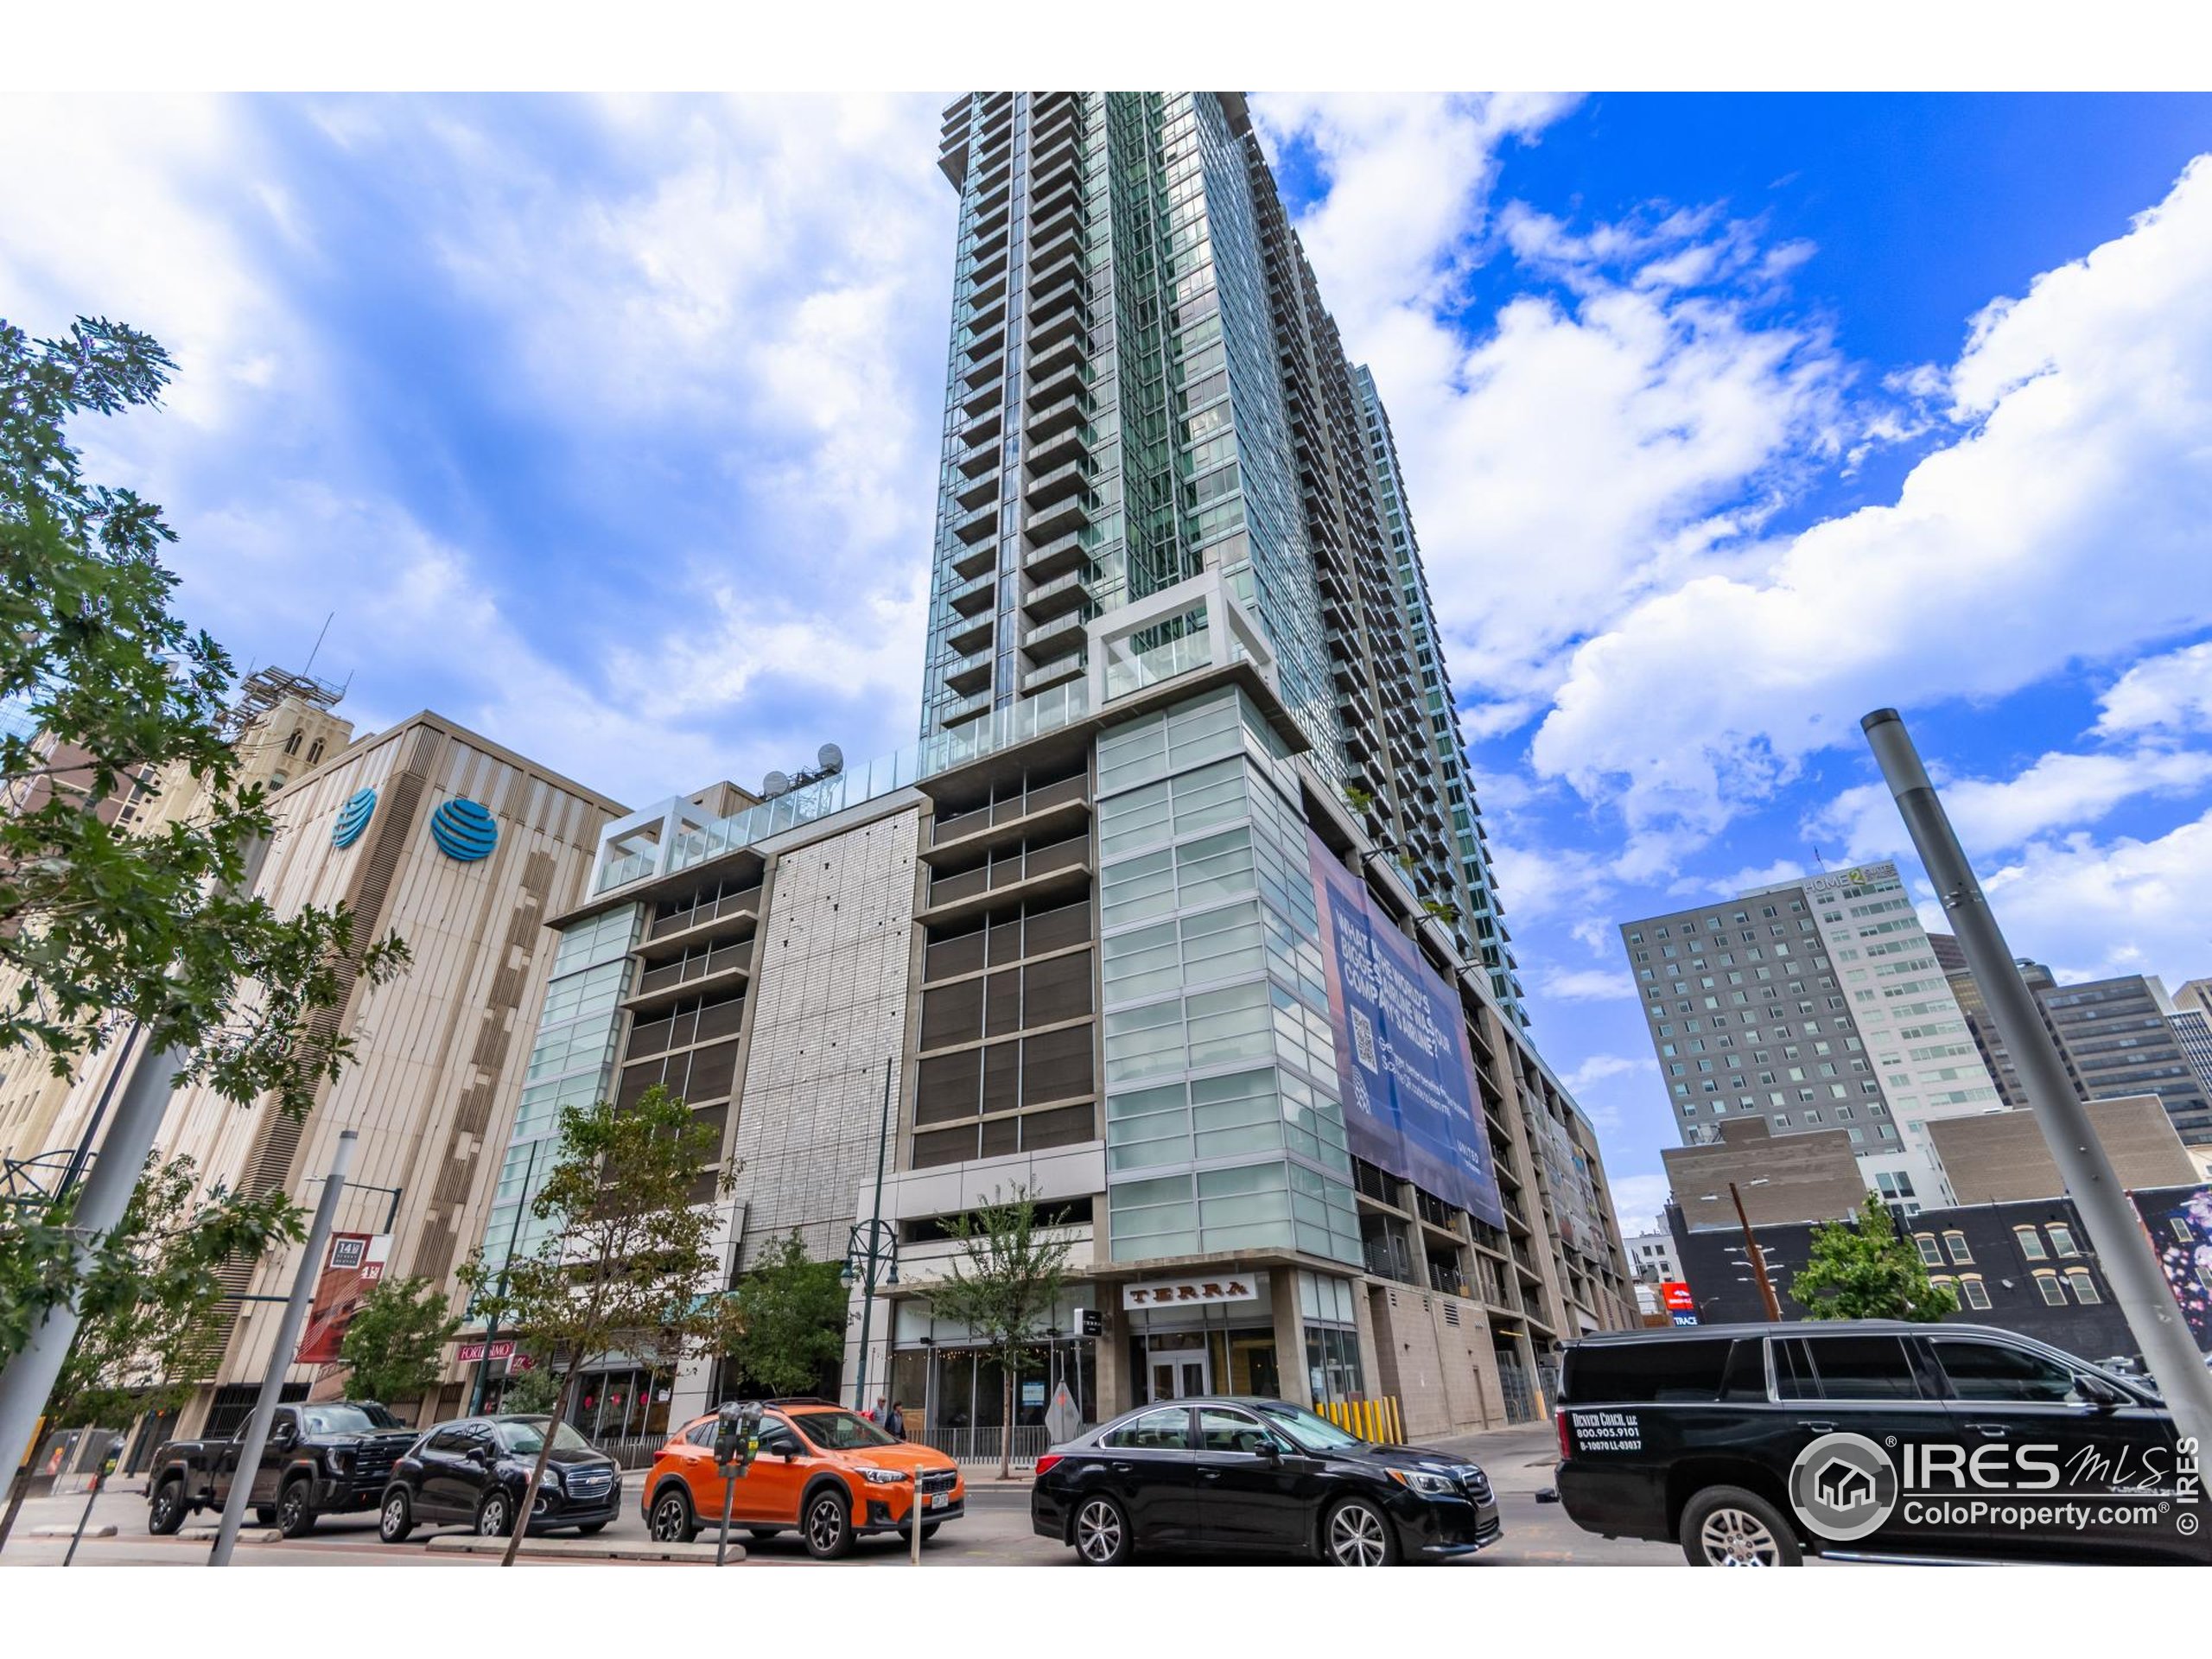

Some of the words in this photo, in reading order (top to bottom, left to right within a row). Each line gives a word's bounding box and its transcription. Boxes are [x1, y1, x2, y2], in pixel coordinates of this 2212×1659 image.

[1804, 874, 1849, 893] HOME
[1849, 868, 1866, 885] 2
[1335, 908, 1368, 955] WHAT
[1340, 933, 1383, 986] BIGGES
[1344, 962, 1402, 1031] COMPAY'S
[1129, 1281, 1249, 1304] TERRA
[1673, 1316, 1698, 1325] TRACE
[1576, 1427, 1640, 1439] 800.905.9101
